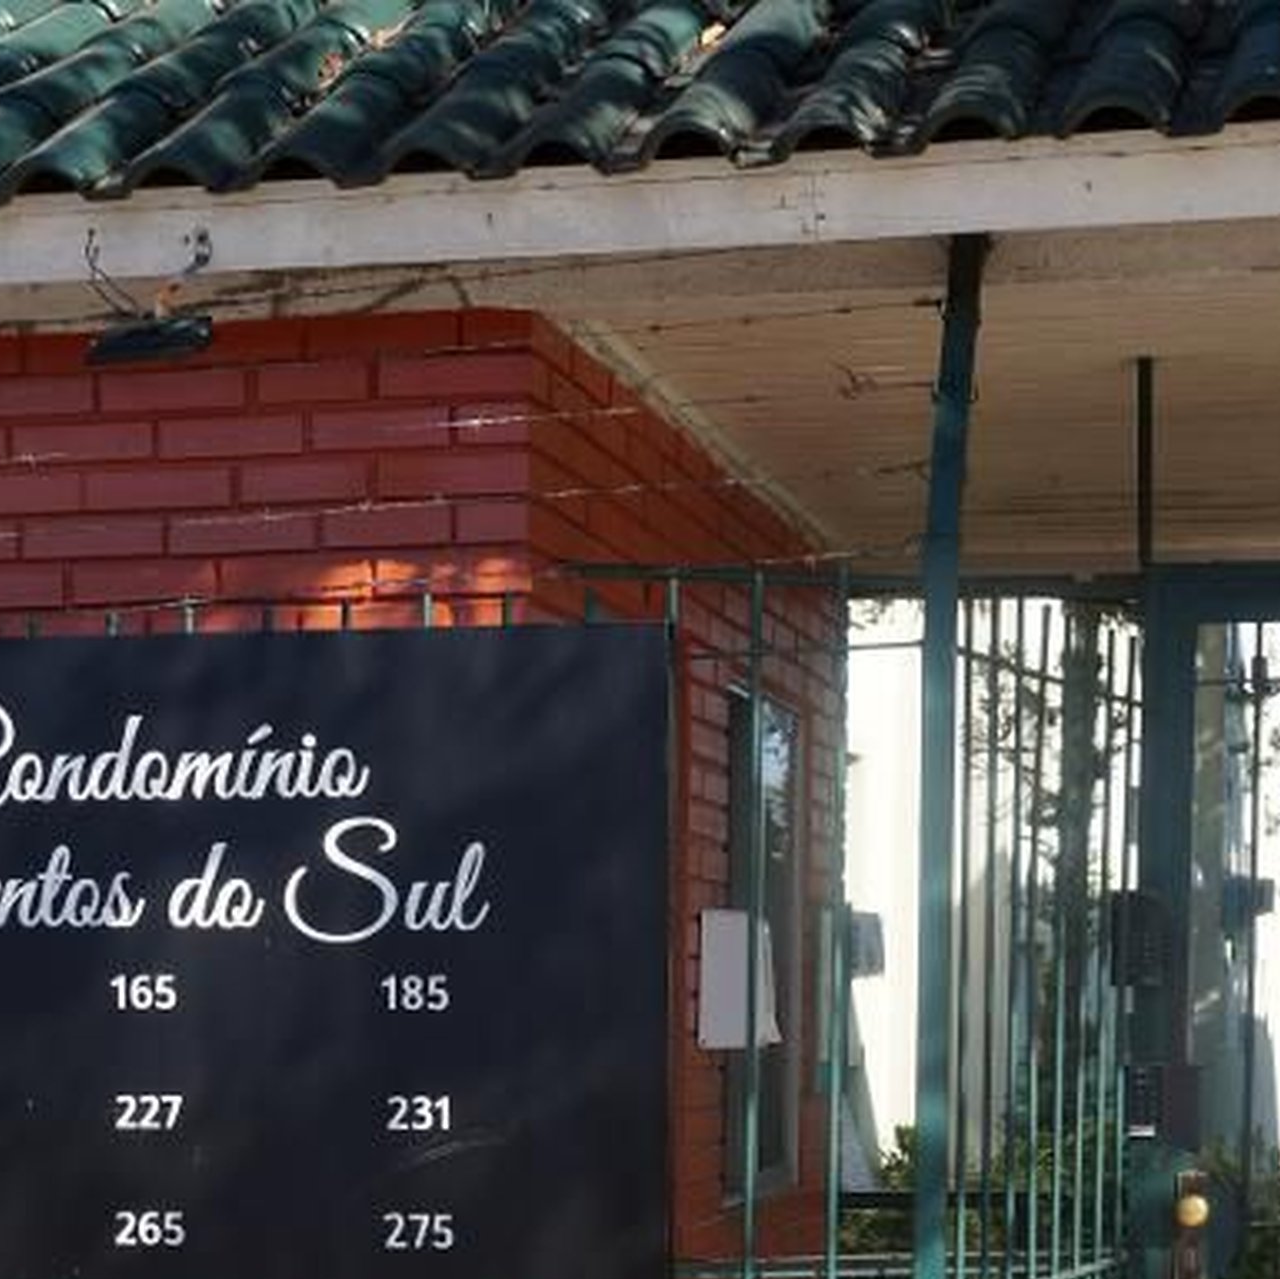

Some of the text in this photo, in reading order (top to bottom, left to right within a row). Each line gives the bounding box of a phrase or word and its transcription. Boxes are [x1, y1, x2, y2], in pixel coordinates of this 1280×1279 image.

[167, 841, 267, 931] do
[283, 816, 490, 944] Sul
[109, 973, 178, 1011] 165
[381, 974, 451, 1011] 185
[114, 1094, 184, 1130] 227
[387, 1095, 451, 1131] 231
[114, 1210, 186, 1247] 265
[383, 1211, 455, 1250] 275
